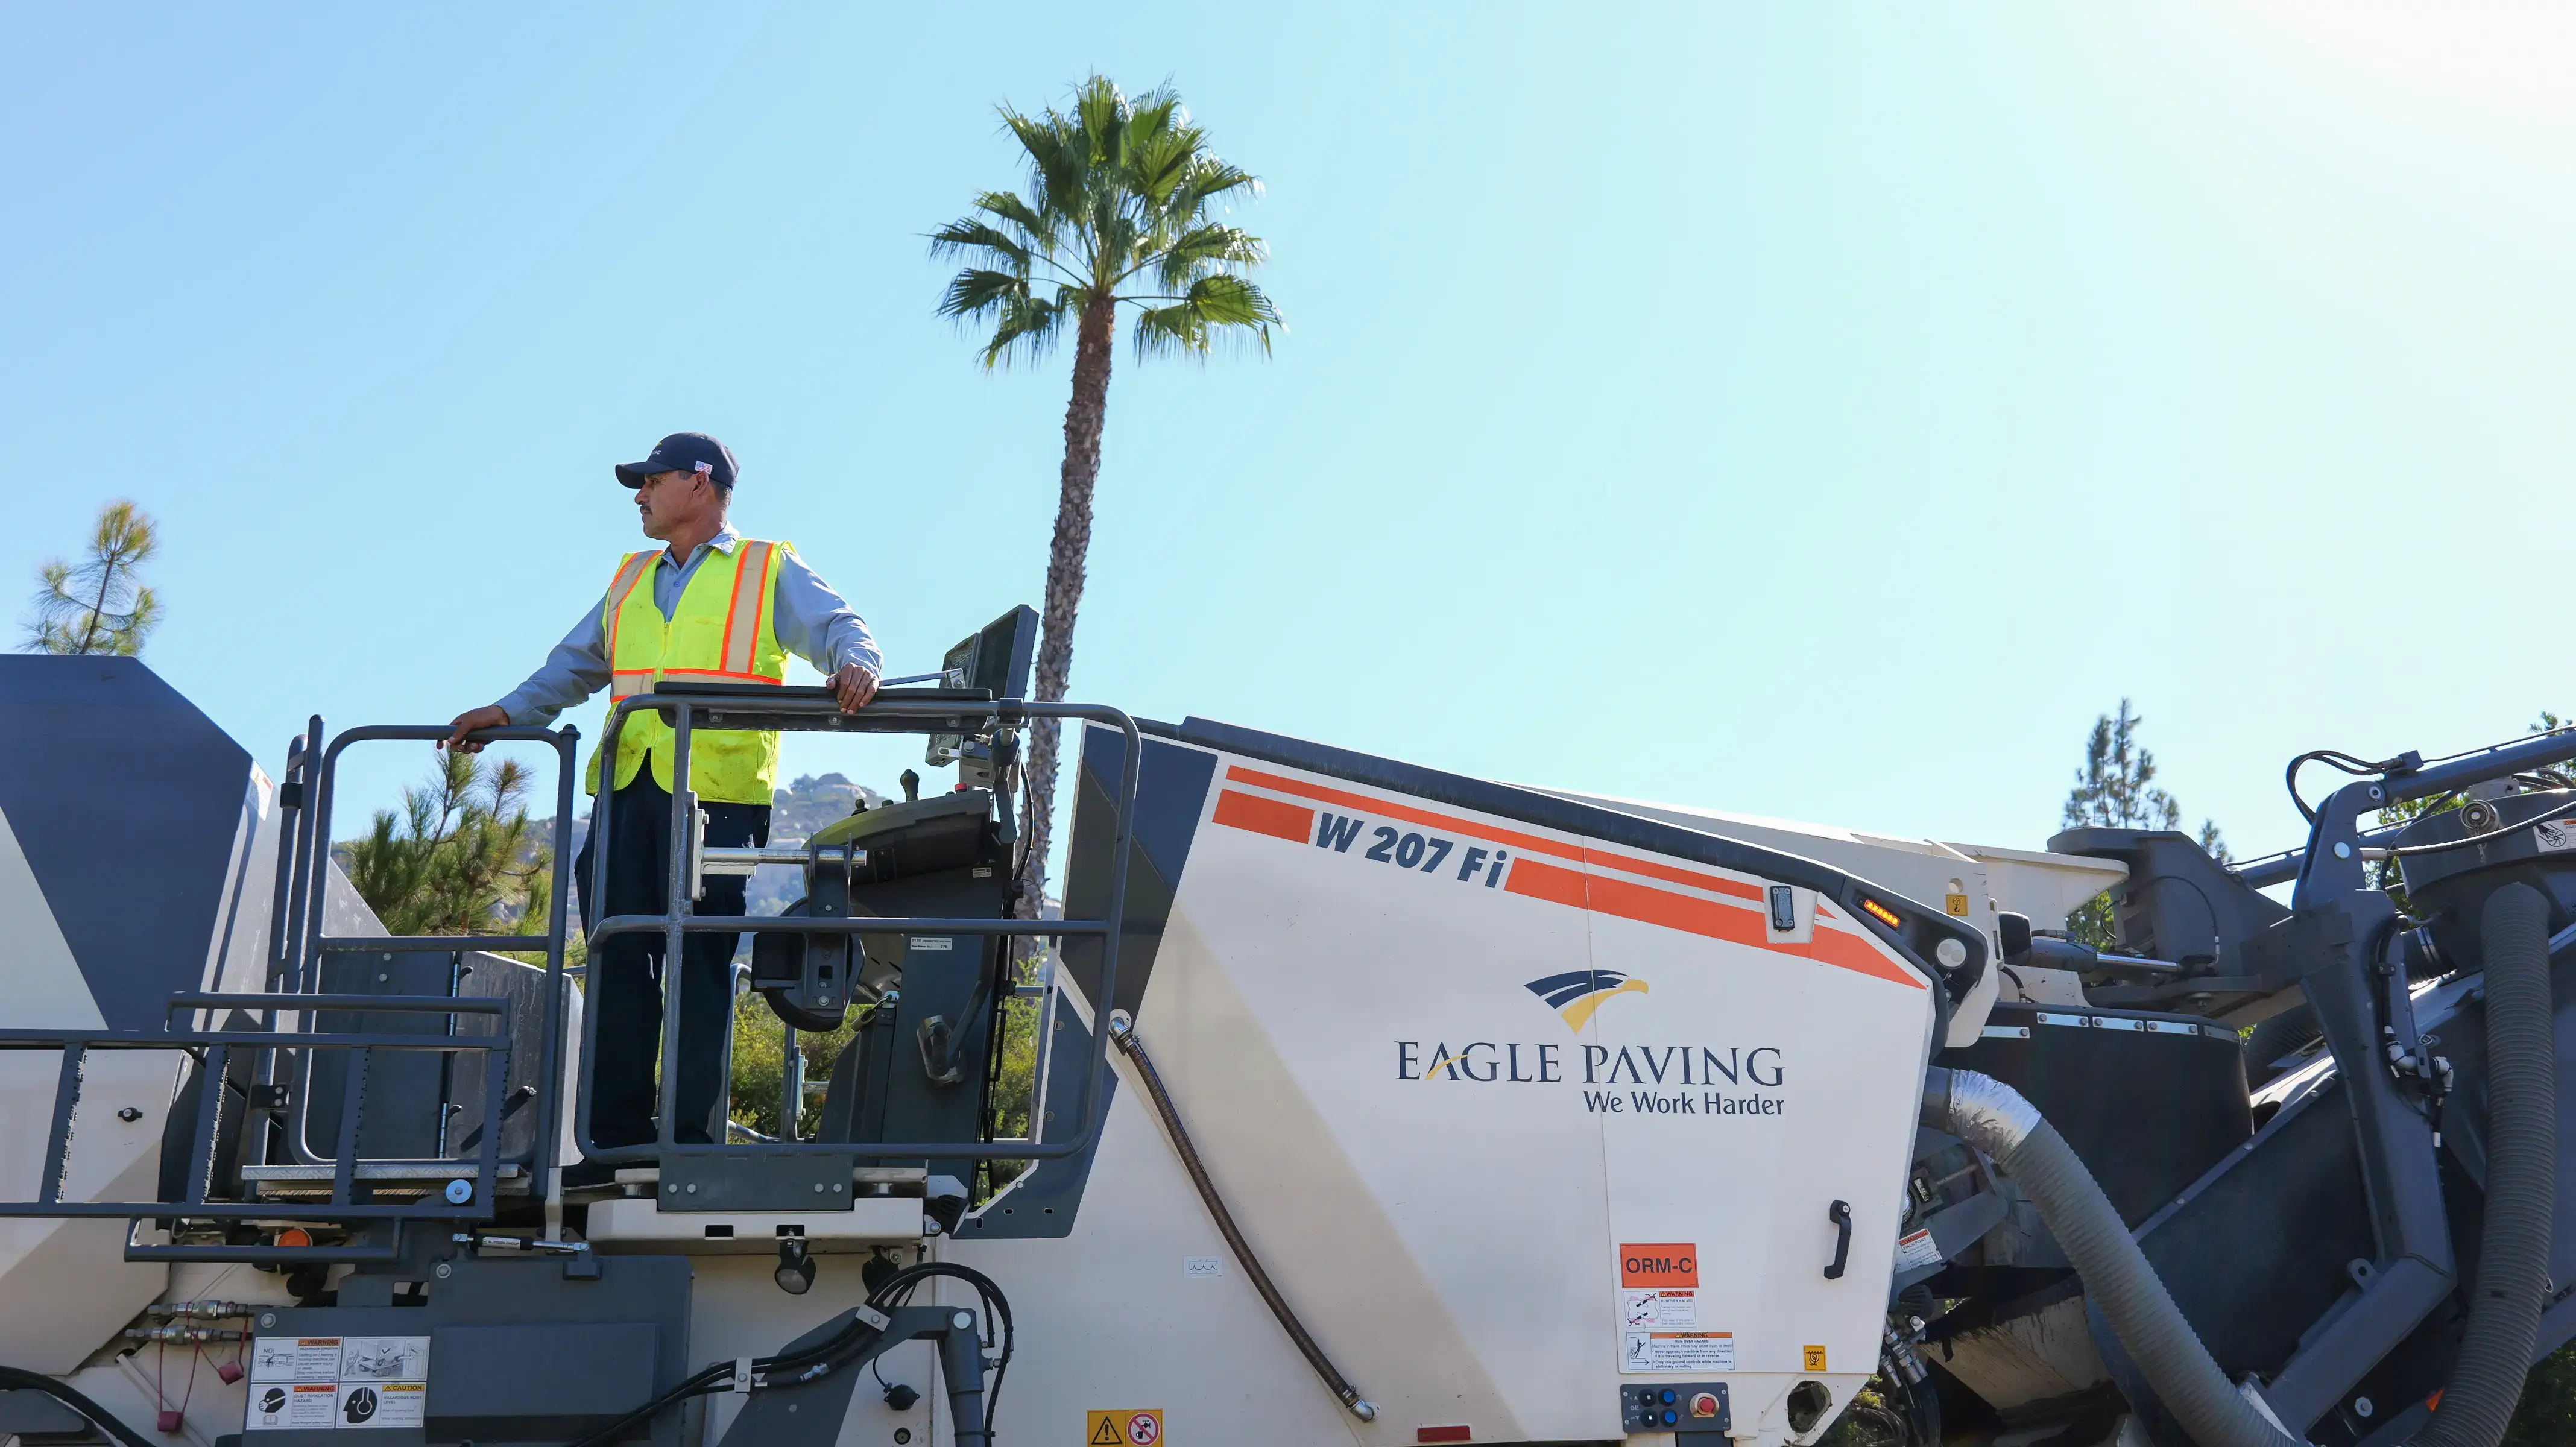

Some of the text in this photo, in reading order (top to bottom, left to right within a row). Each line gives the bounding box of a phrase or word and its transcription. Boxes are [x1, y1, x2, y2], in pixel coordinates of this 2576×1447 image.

[1316, 812, 1507, 888] W 207 Fi
[1394, 1041, 1785, 1086] EAGLE PAVING
[1583, 1091, 1784, 1115] We Work Harder
[1906, 1231, 1928, 1243] WARNING
[1626, 1258, 1692, 1273] ORM-C
